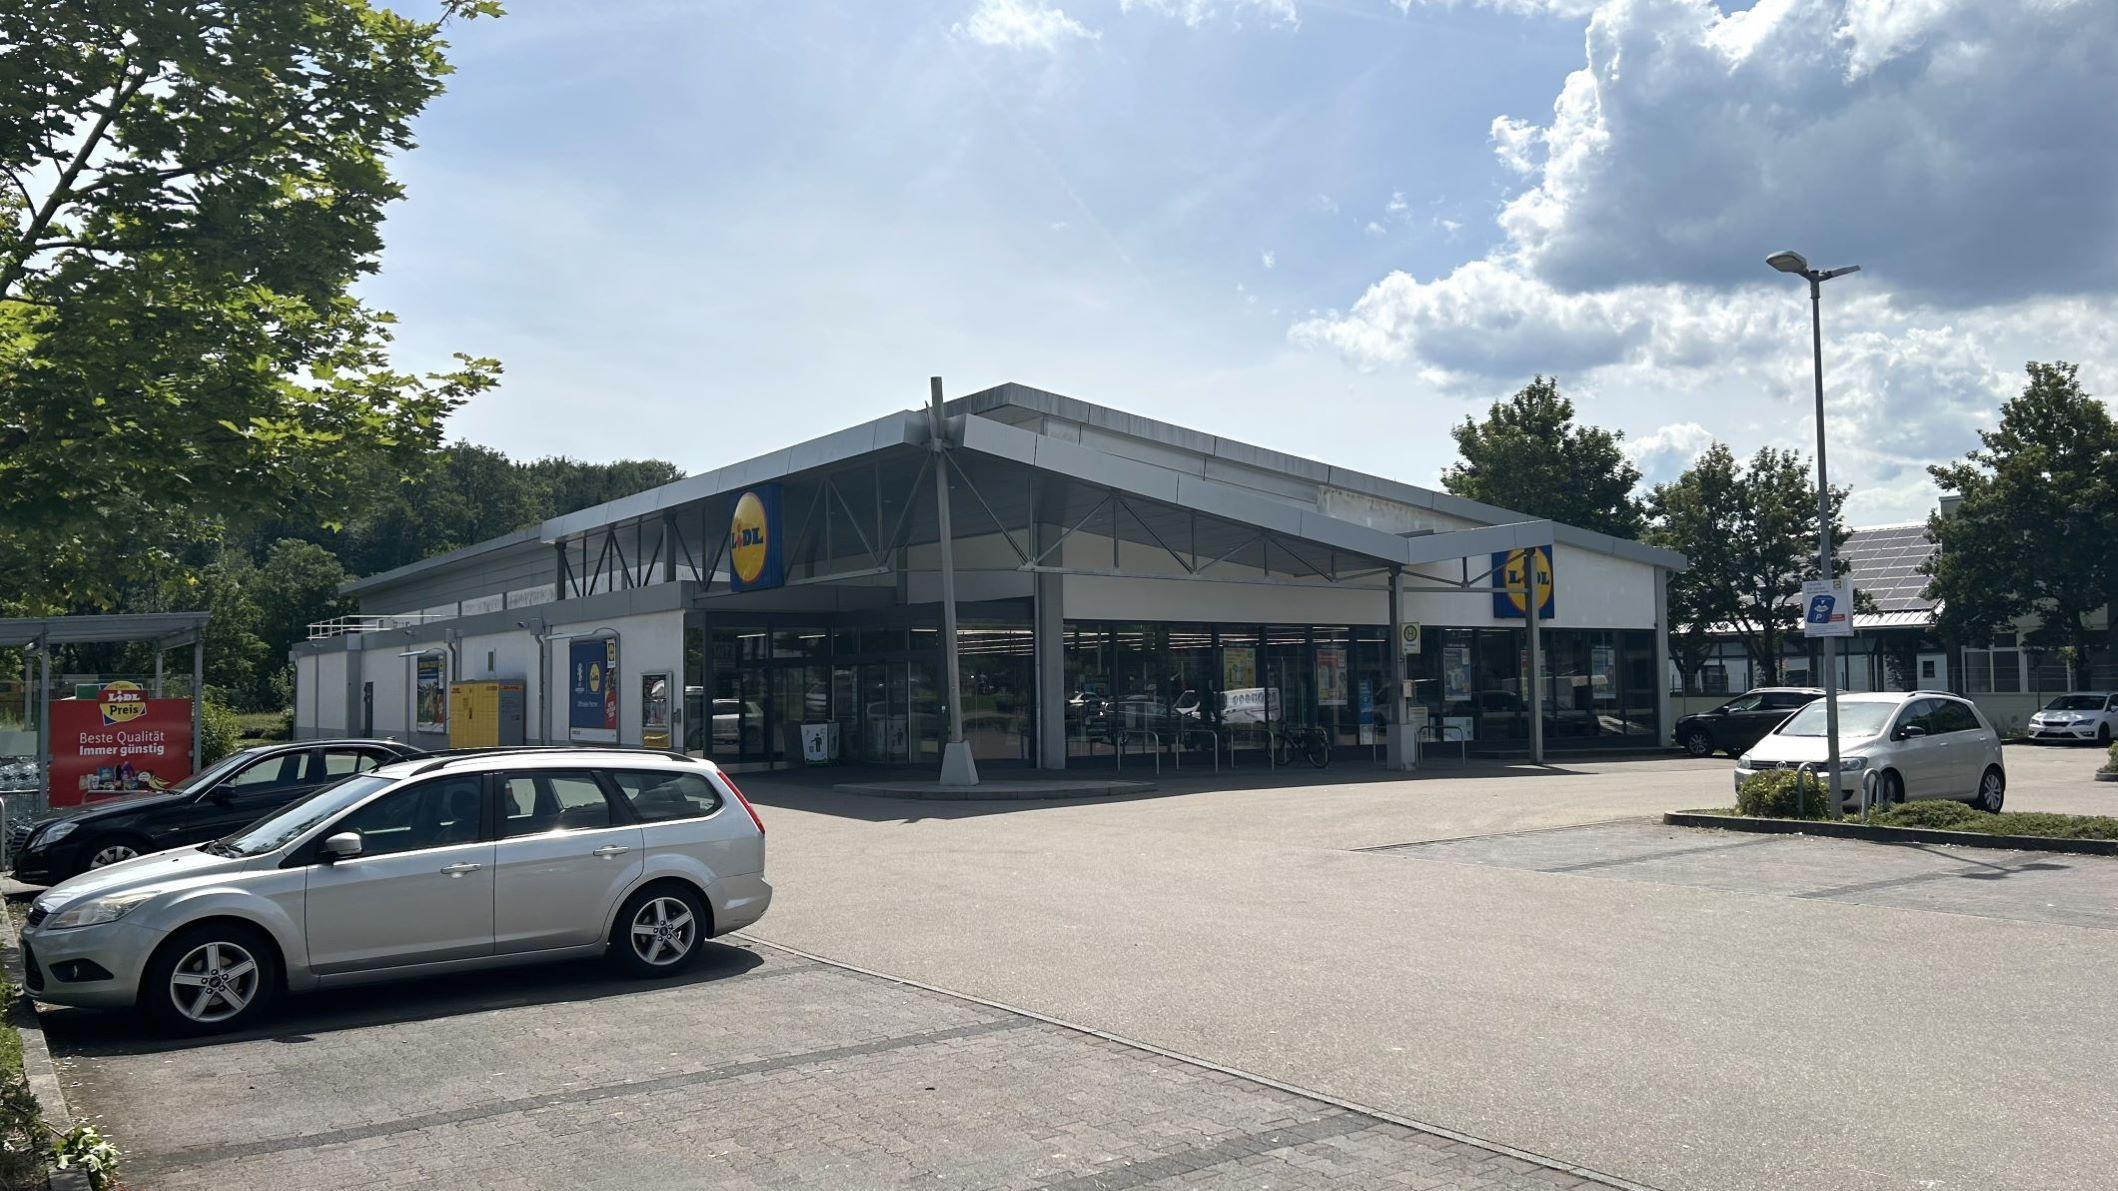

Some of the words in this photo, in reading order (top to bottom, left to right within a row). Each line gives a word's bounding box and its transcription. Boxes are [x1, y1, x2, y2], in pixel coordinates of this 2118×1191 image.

[109, 704, 138, 715] Preis
[80, 732, 113, 744] Beste
[117, 731, 165, 744] Qualität
[80, 745, 118, 756] Immer
[120, 742, 165, 757] günstig
